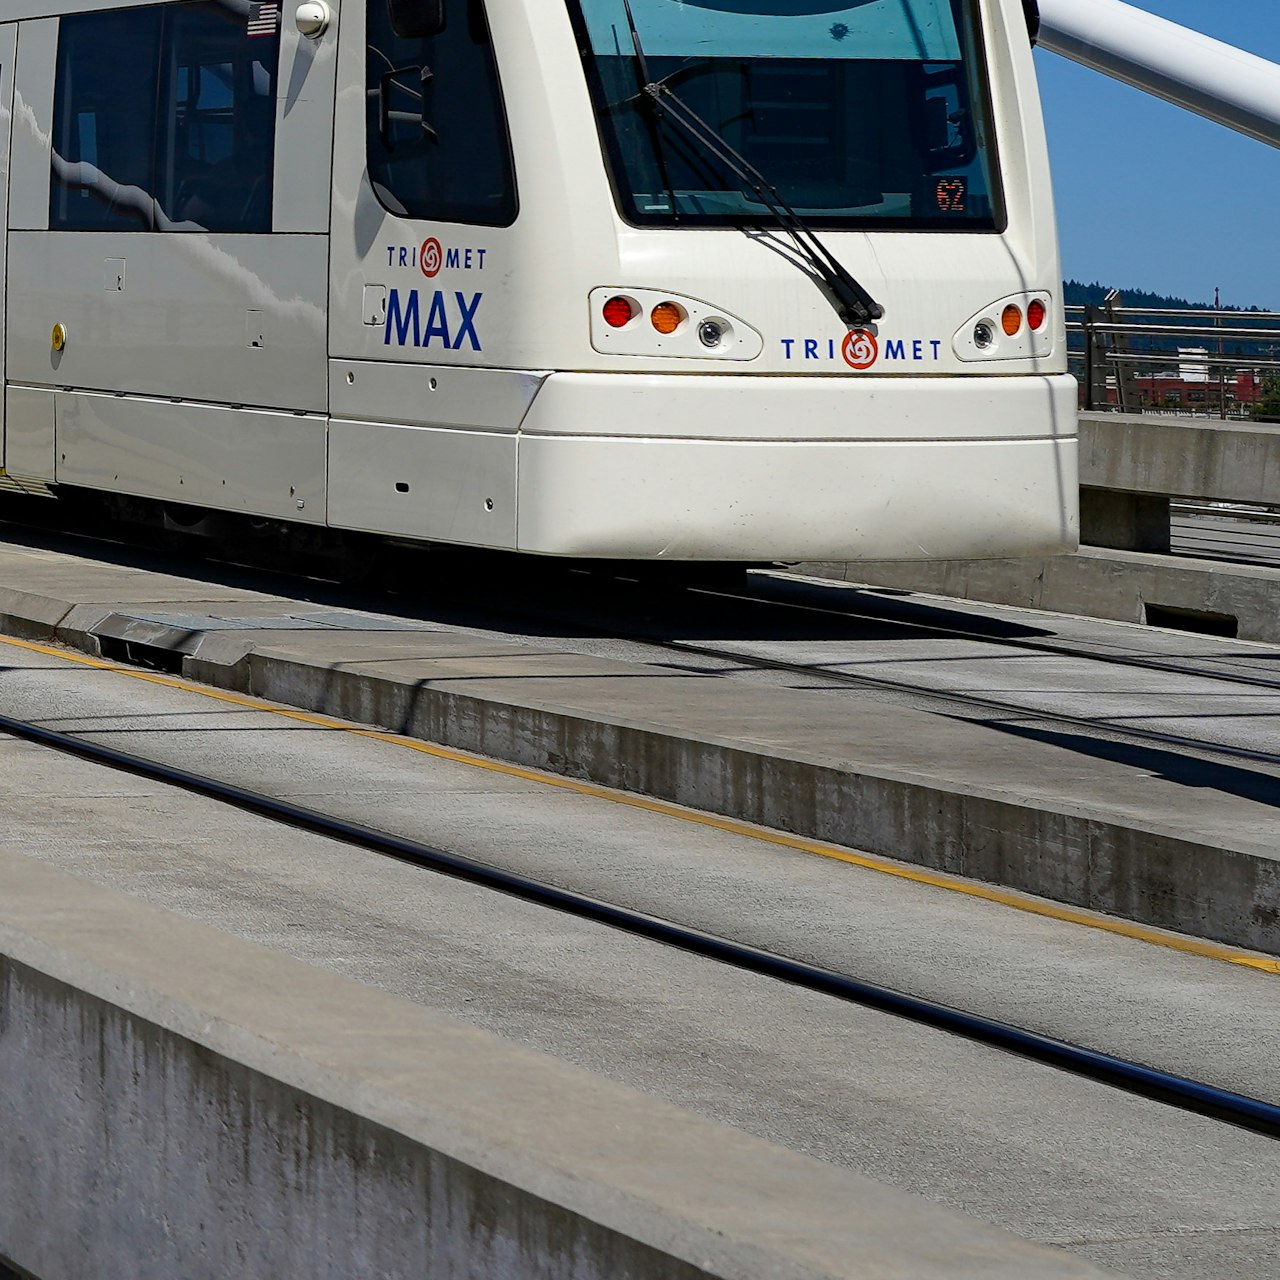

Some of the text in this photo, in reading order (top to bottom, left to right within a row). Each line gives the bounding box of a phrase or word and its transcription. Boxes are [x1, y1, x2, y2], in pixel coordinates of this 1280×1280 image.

[936, 179, 964, 211] 62
[387, 246, 487, 269] TRI MET
[384, 288, 484, 352] MAX
[781, 339, 941, 360] TRI MET
